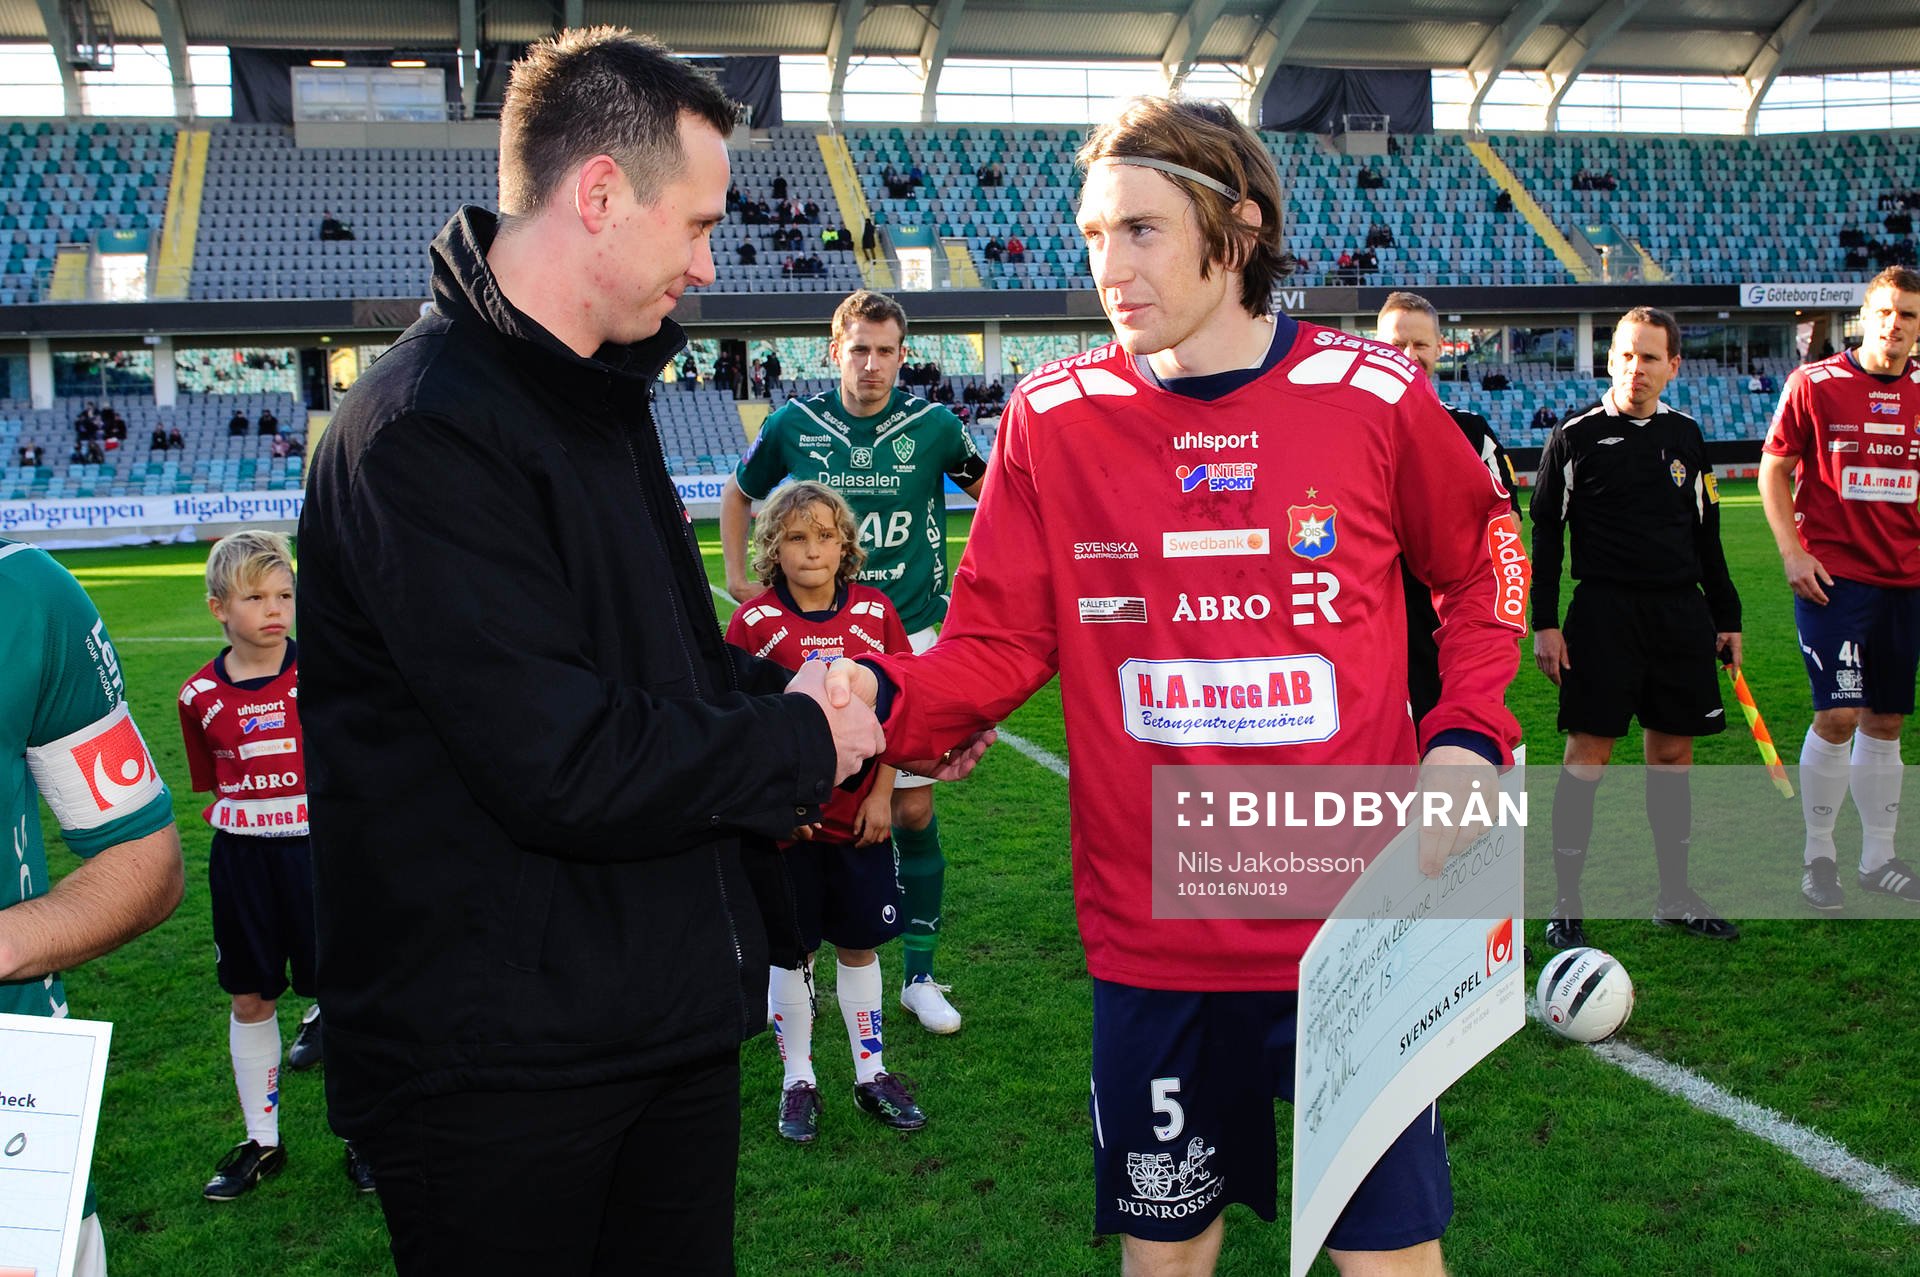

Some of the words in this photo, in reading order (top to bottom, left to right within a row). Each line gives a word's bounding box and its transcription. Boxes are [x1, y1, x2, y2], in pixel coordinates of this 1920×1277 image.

[1768, 288, 1818, 304] Göteborg
[1820, 288, 1854, 303] Energi
[1313, 331, 1418, 374] Stavdal
[1173, 431, 1259, 452] uhlsport
[818, 472, 900, 487] Dalasalen
[1209, 464, 1254, 477] INTER
[1210, 477, 1253, 490] SPORT
[0, 502, 144, 528] gabgruppen
[1074, 542, 1138, 553] SVENSKA
[1169, 536, 1244, 552] Swedbank
[1494, 527, 1526, 616] Adecco
[1172, 593, 1270, 622] ÅBRO
[85, 636, 100, 662] YOUR
[800, 636, 844, 648] uhlsport
[849, 624, 886, 655] Stavda
[238, 700, 285, 716] uhlsport
[1141, 709, 1316, 734] Betongentreprenören
[241, 772, 298, 790] ÅBRO
[1561, 960, 1590, 996] uhlsport
[857, 1011, 872, 1037] INTER
[1400, 996, 1450, 1056] SVENSKA
[1454, 971, 1481, 1004] SPEL
[1151, 1077, 1184, 1141] 5
